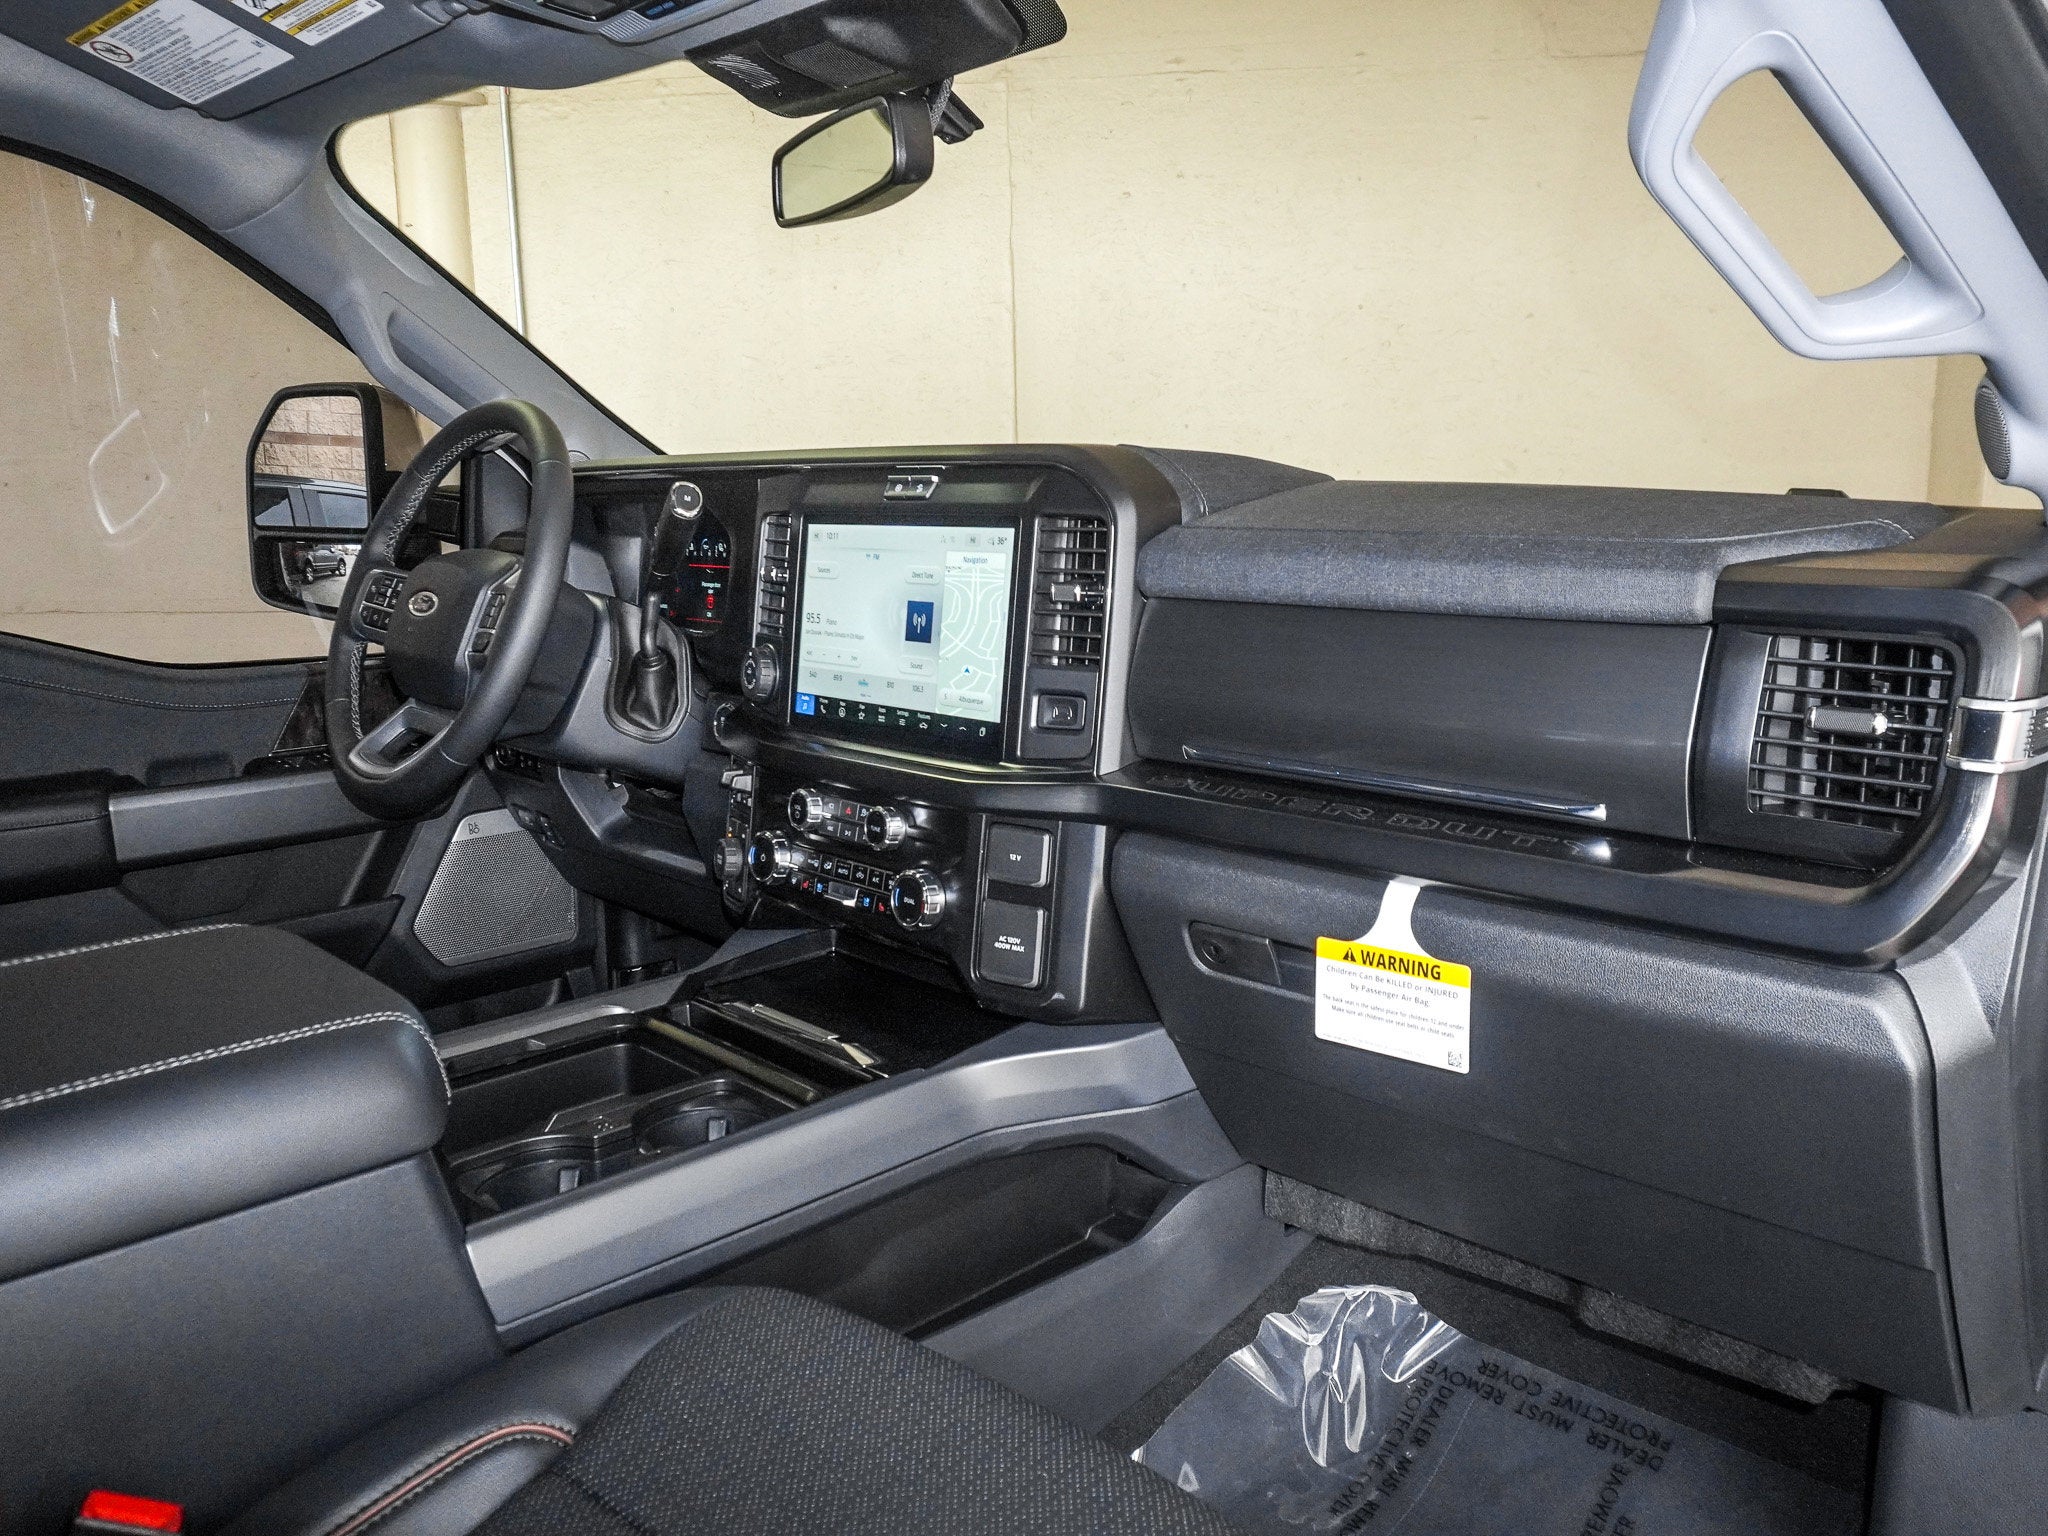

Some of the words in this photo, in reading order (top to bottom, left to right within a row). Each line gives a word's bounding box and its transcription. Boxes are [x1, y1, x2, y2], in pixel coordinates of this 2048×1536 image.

[963, 556, 988, 565] Navigation
[806, 612, 821, 624] 95.5
[910, 661, 923, 670] Sound
[903, 896, 916, 905] DUAL
[998, 935, 1007, 943] AC
[1007, 936, 1021, 945] 120V
[1011, 943, 1025, 953] MAX
[1361, 949, 1441, 981] WARNING
[1326, 965, 1357, 978] Children
[1359, 971, 1373, 981] Can
[1375, 975, 1385, 984] Be
[1386, 977, 1413, 990] KILLED
[1425, 985, 1459, 1000] INJURED
[1350, 983, 1359, 993] by
[1361, 985, 1399, 1001] Passenger
[1401, 993, 1412, 1002] Air
[1477, 1358, 1542, 1397] COVER
[1411, 1384, 1454, 1449] DEALER
[1515, 1400, 1575, 1434] MUST
[1550, 1390, 1674, 1452] PROTECTIVE
[1587, 1427, 1664, 1472] DEALER
